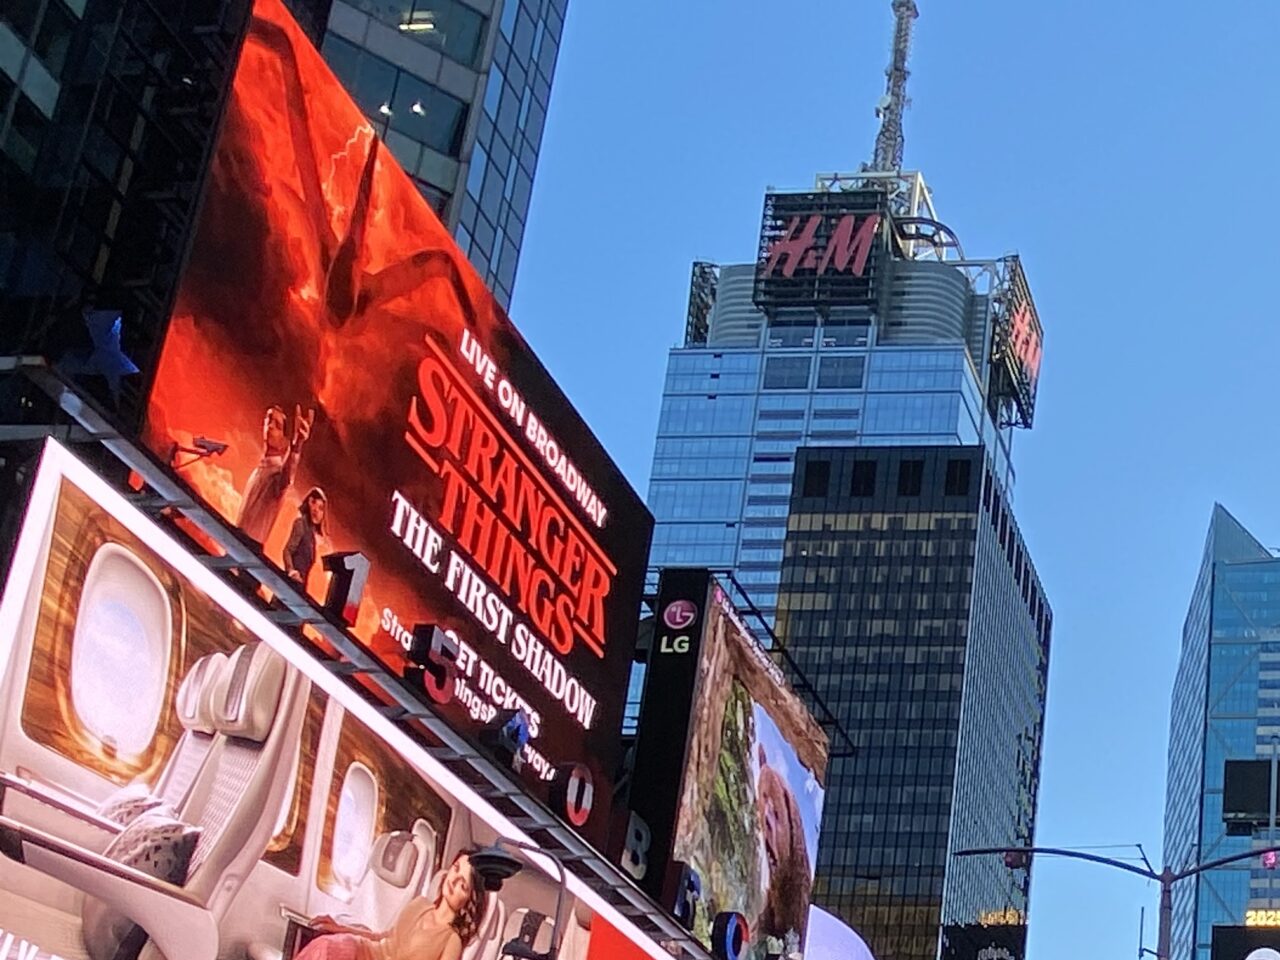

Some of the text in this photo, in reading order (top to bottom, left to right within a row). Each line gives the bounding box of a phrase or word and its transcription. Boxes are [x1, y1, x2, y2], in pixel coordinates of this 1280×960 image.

[408, 357, 610, 644] STRANGER
[460, 328, 607, 528] LIVE ON BROADWAY
[390, 490, 598, 730] THE FIRST SHADOW
[439, 460, 576, 655] THINGS
[444, 630, 478, 678] ET
[660, 636, 689, 653] LG
